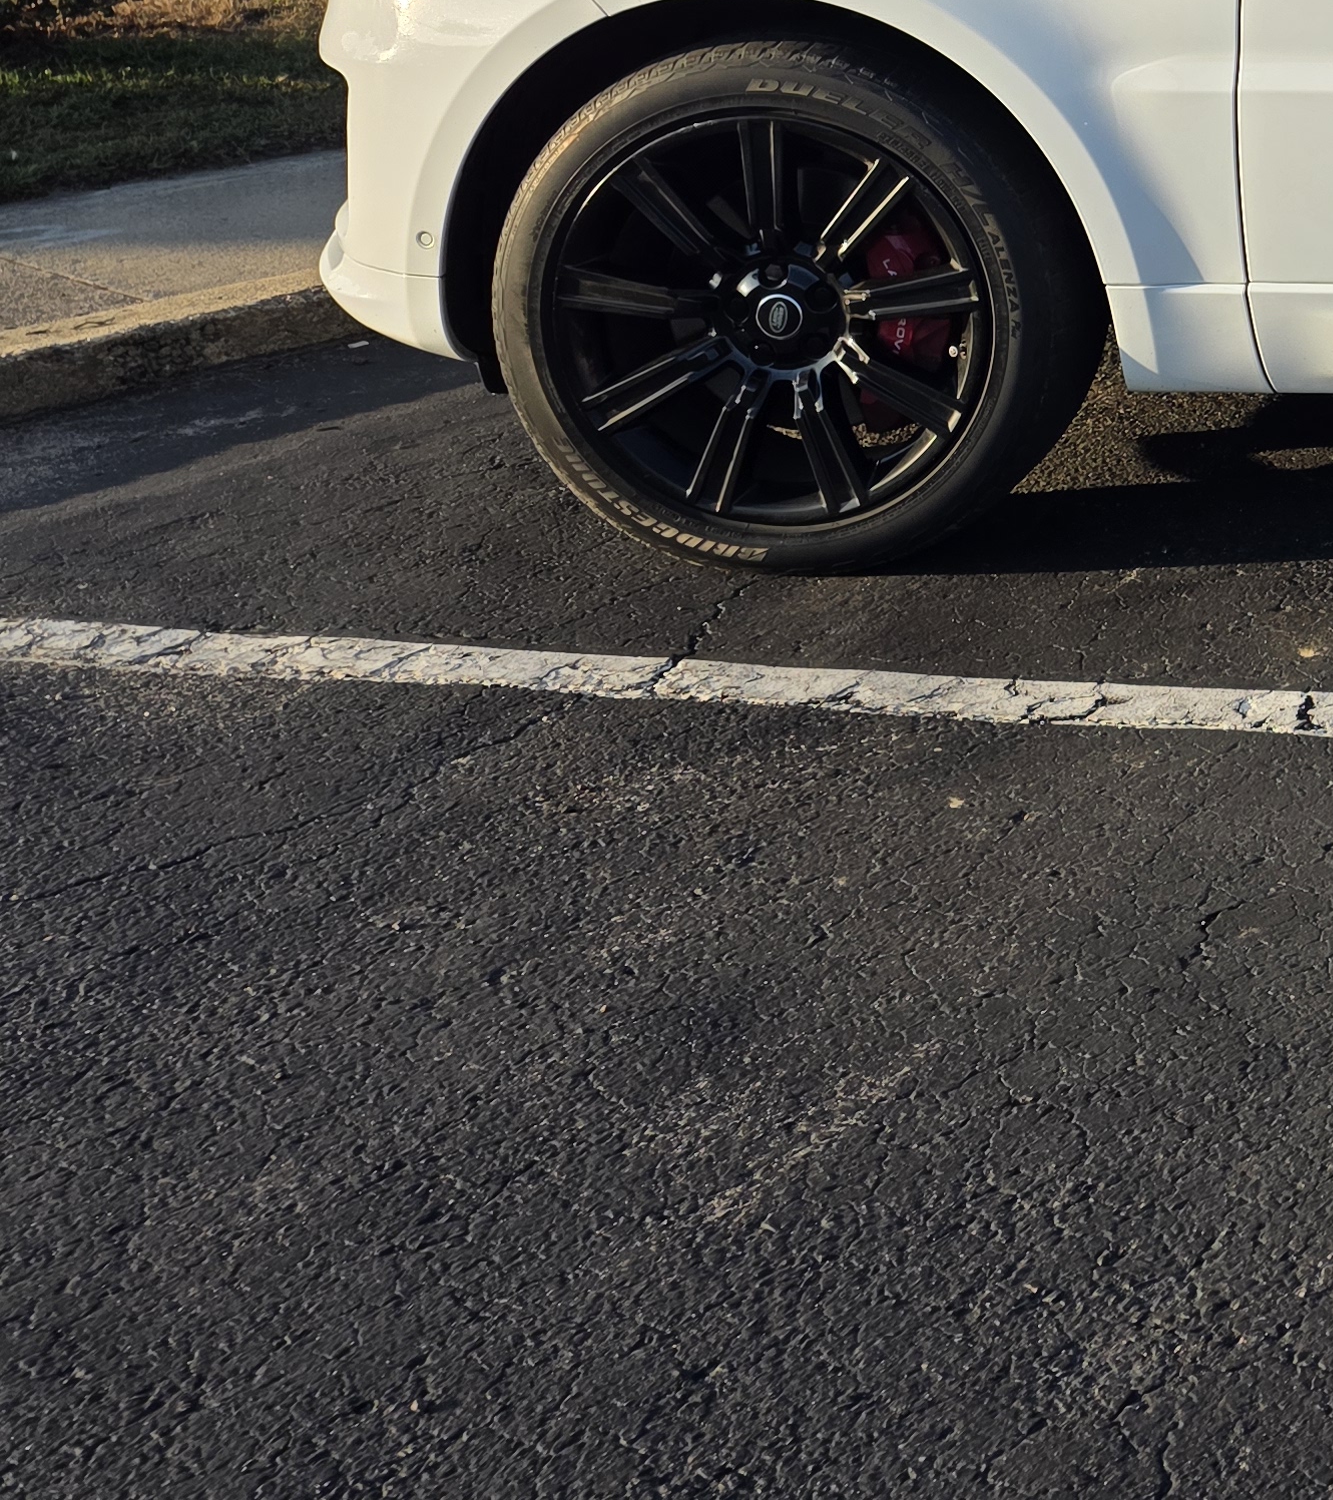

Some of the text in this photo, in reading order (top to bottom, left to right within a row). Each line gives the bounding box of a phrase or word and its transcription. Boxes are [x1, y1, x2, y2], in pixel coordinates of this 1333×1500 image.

[745, 78, 932, 150] DUELER
[988, 231, 1020, 313] ALENZA
[552, 437, 770, 562] BRIDGESTONE
